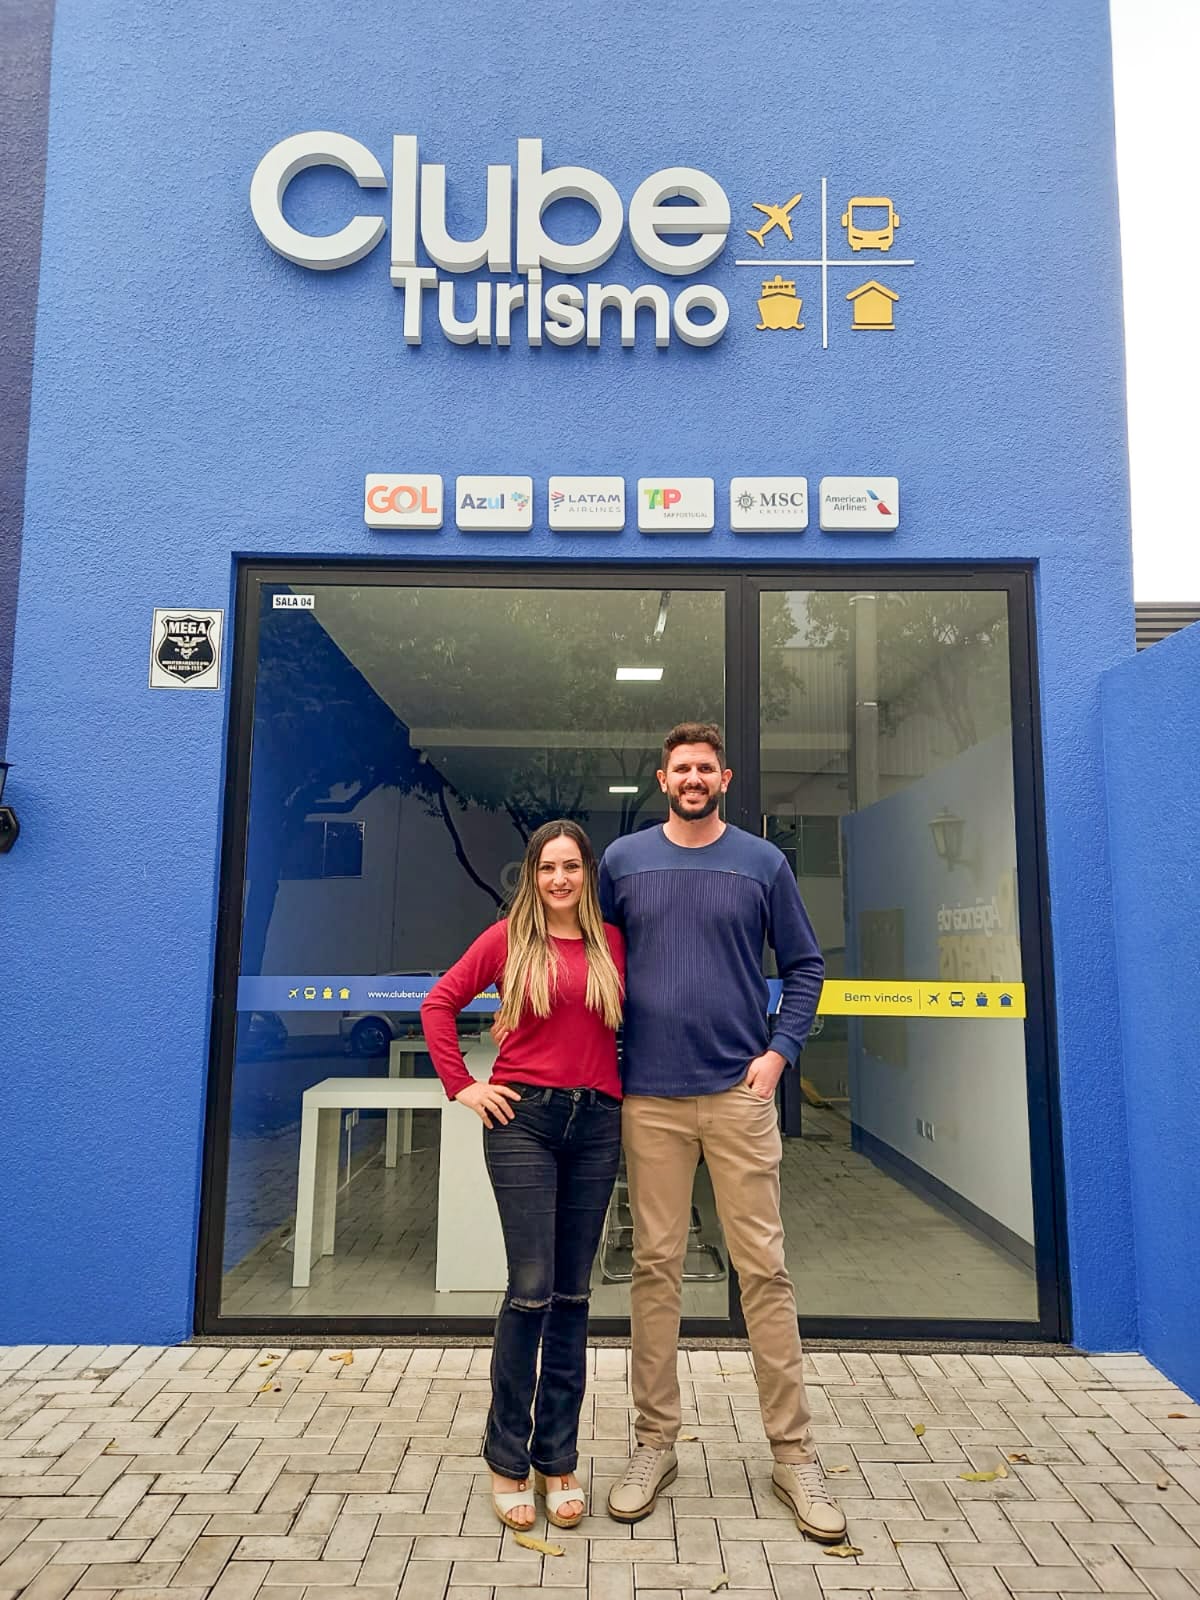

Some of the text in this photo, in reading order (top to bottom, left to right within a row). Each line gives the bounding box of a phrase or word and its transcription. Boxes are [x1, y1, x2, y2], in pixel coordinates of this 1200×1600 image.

[250, 131, 731, 275] Clube
[390, 266, 730, 348] Turismo
[367, 485, 438, 514] GOL
[461, 493, 505, 510] Azul
[568, 494, 621, 504] LATAM
[644, 488, 682, 510] TAP
[759, 492, 804, 507] MSC
[825, 494, 867, 503] American
[833, 503, 867, 511] Airlines
[275, 596, 312, 607] SALA 04
[168, 621, 208, 635] MEGA
[844, 991, 913, 1004] Bem vindos
